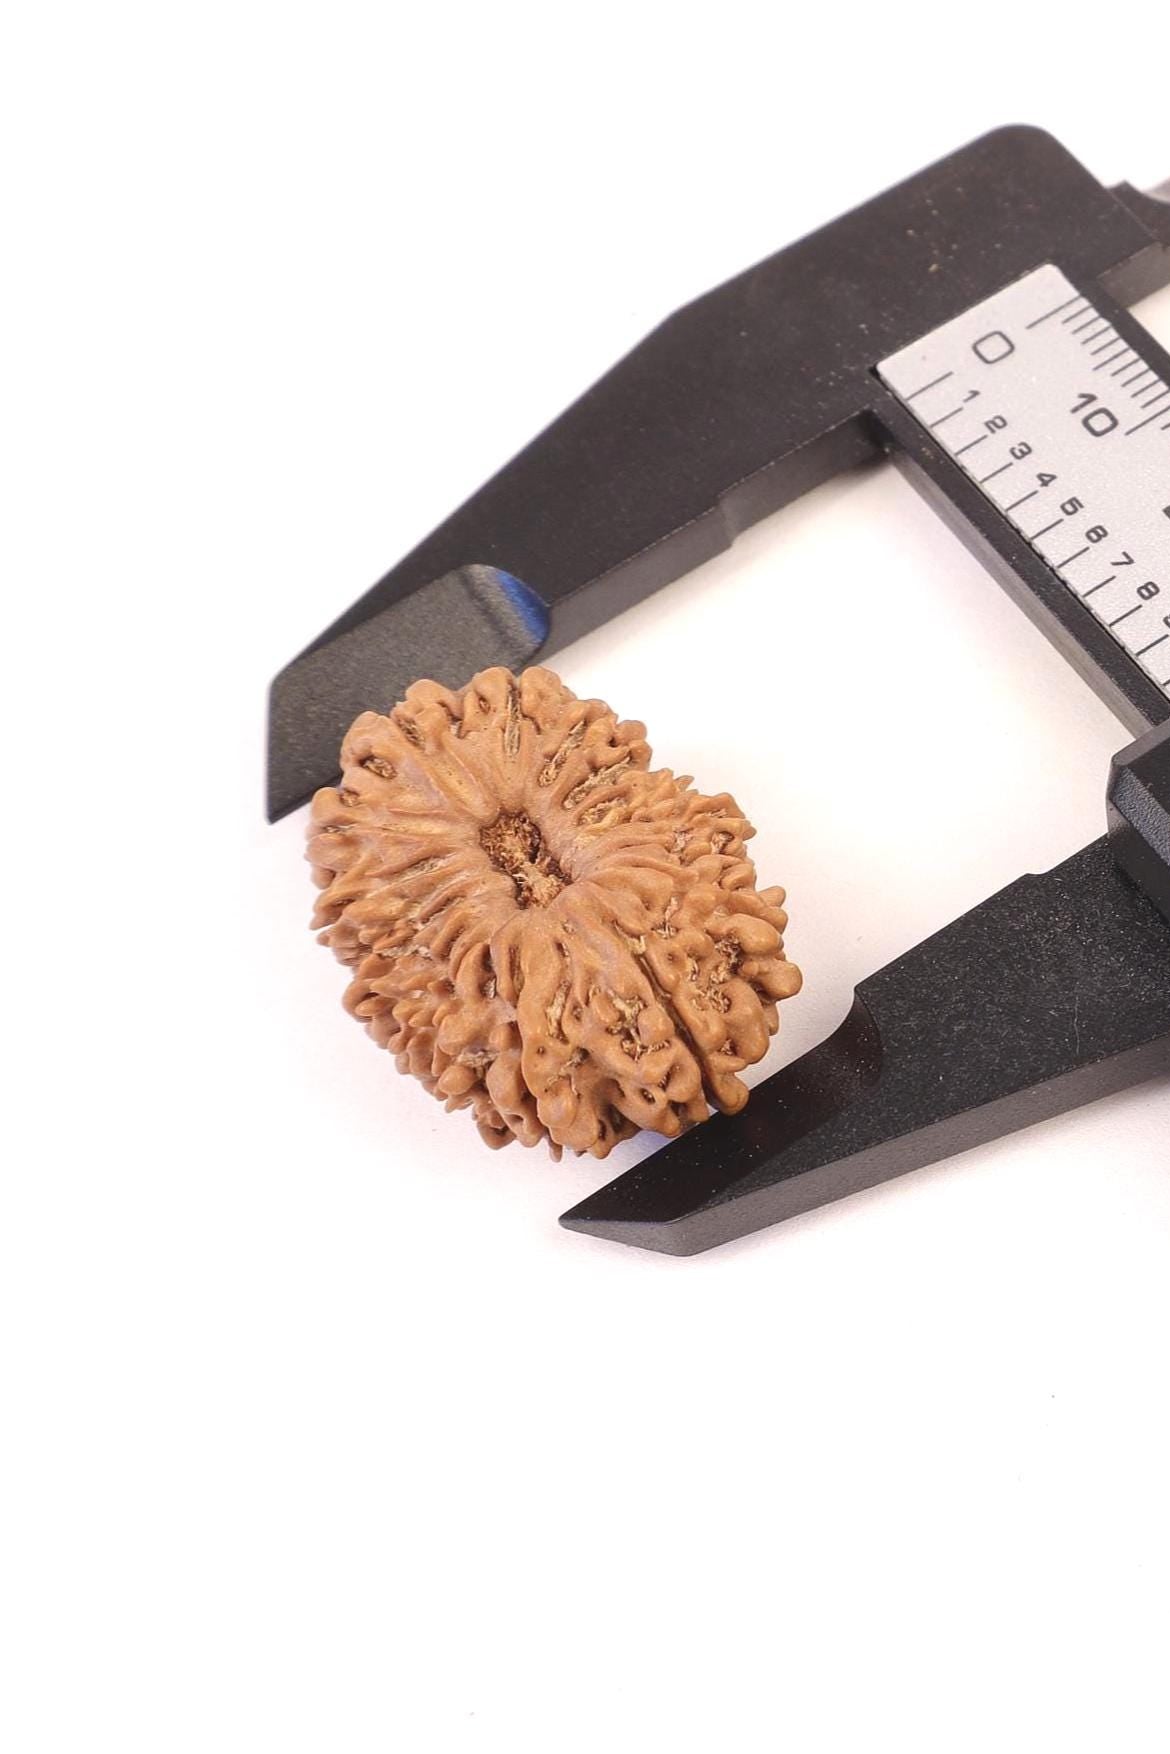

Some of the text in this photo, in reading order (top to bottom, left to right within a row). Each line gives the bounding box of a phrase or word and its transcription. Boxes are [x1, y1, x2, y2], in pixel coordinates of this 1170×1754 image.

[971, 330, 1016, 365] 0
[963, 388, 981, 403] 1
[984, 414, 1008, 434] 2
[1069, 390, 1120, 438] 10
[1009, 440, 1033, 461] 3
[1036, 468, 1058, 488] 4
[1060, 496, 1085, 517] 5
[1085, 524, 1109, 545] 6
[1111, 551, 1135, 571] 7
[1136, 580, 1160, 602] 8
